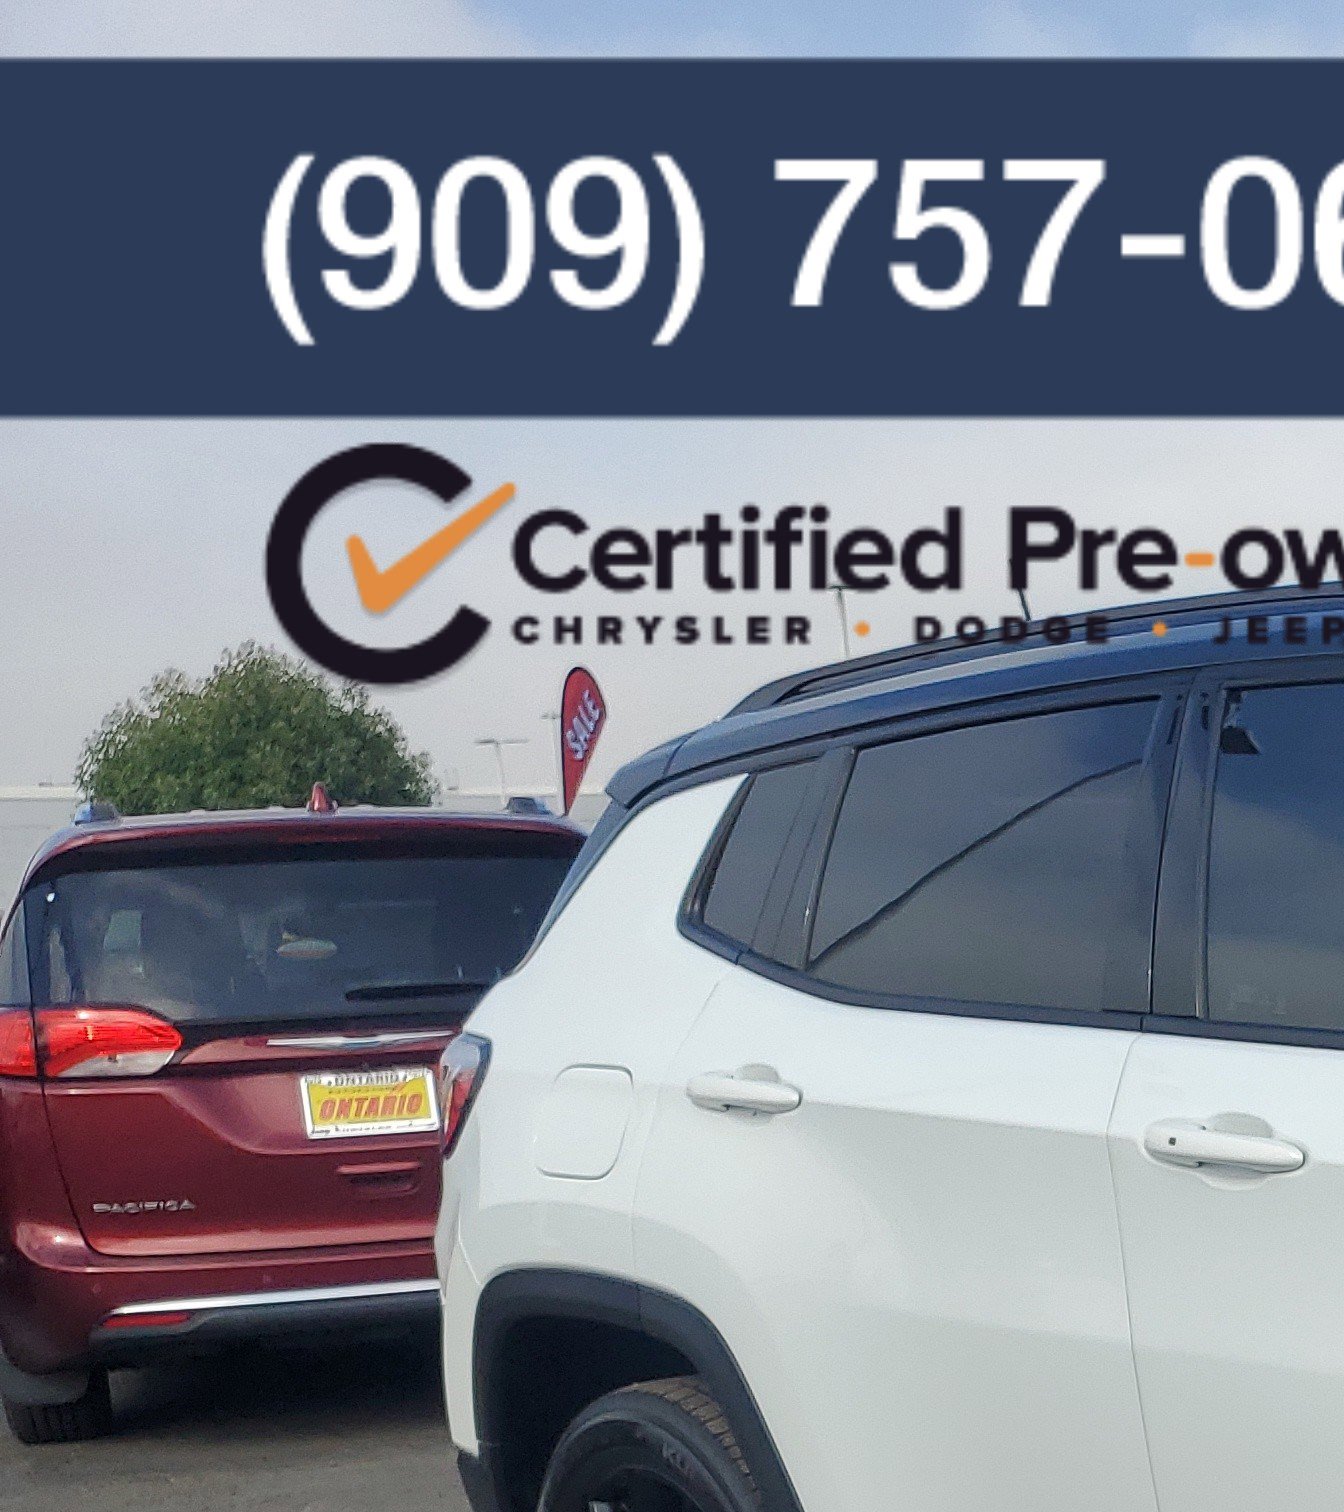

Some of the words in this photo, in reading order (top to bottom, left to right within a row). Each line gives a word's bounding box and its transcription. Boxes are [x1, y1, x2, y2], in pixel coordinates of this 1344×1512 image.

[565, 688, 601, 760] SALE
[317, 1092, 424, 1122] ONTARIO
[92, 1199, 195, 1214] PACIFICA
